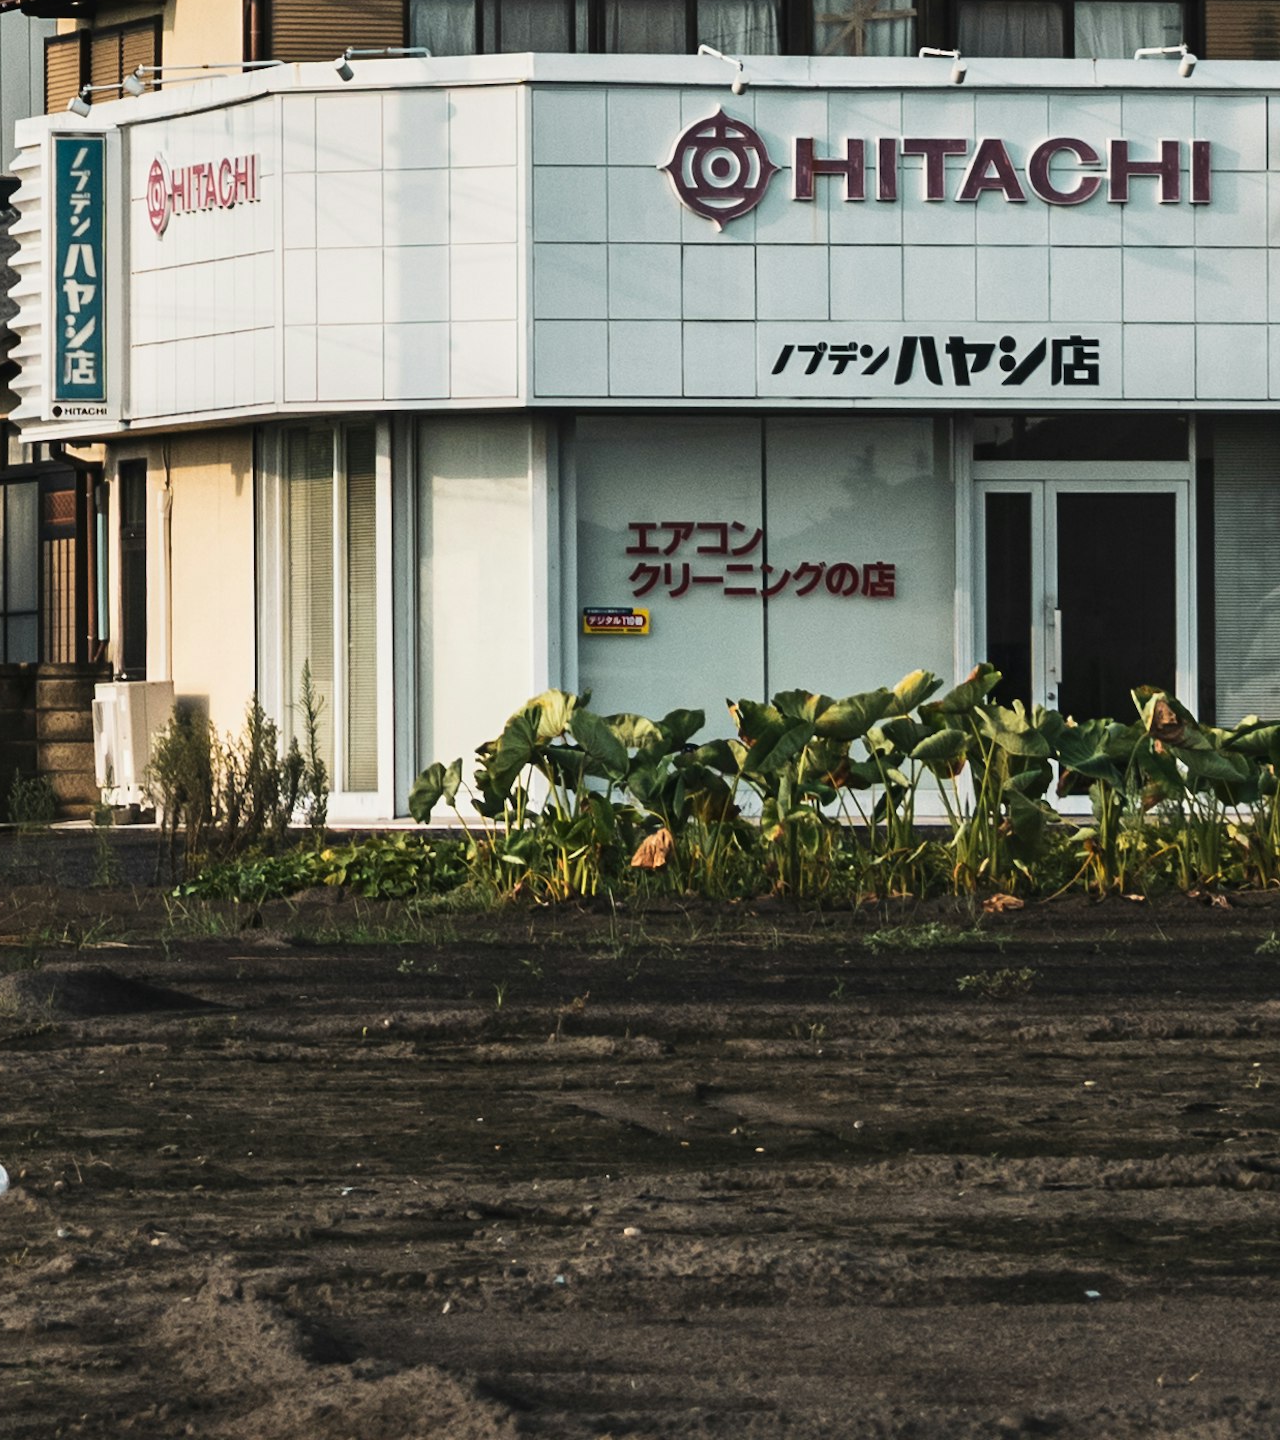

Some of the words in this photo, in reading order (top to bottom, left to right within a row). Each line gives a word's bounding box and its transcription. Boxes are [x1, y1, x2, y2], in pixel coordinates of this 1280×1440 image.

[171, 154, 260, 214] HITACHI
[792, 137, 1212, 205] HITACHI
[65, 407, 107, 415] HITACHI
[626, 520, 763, 556] エアコン
[628, 561, 896, 598] クリーニングの店
